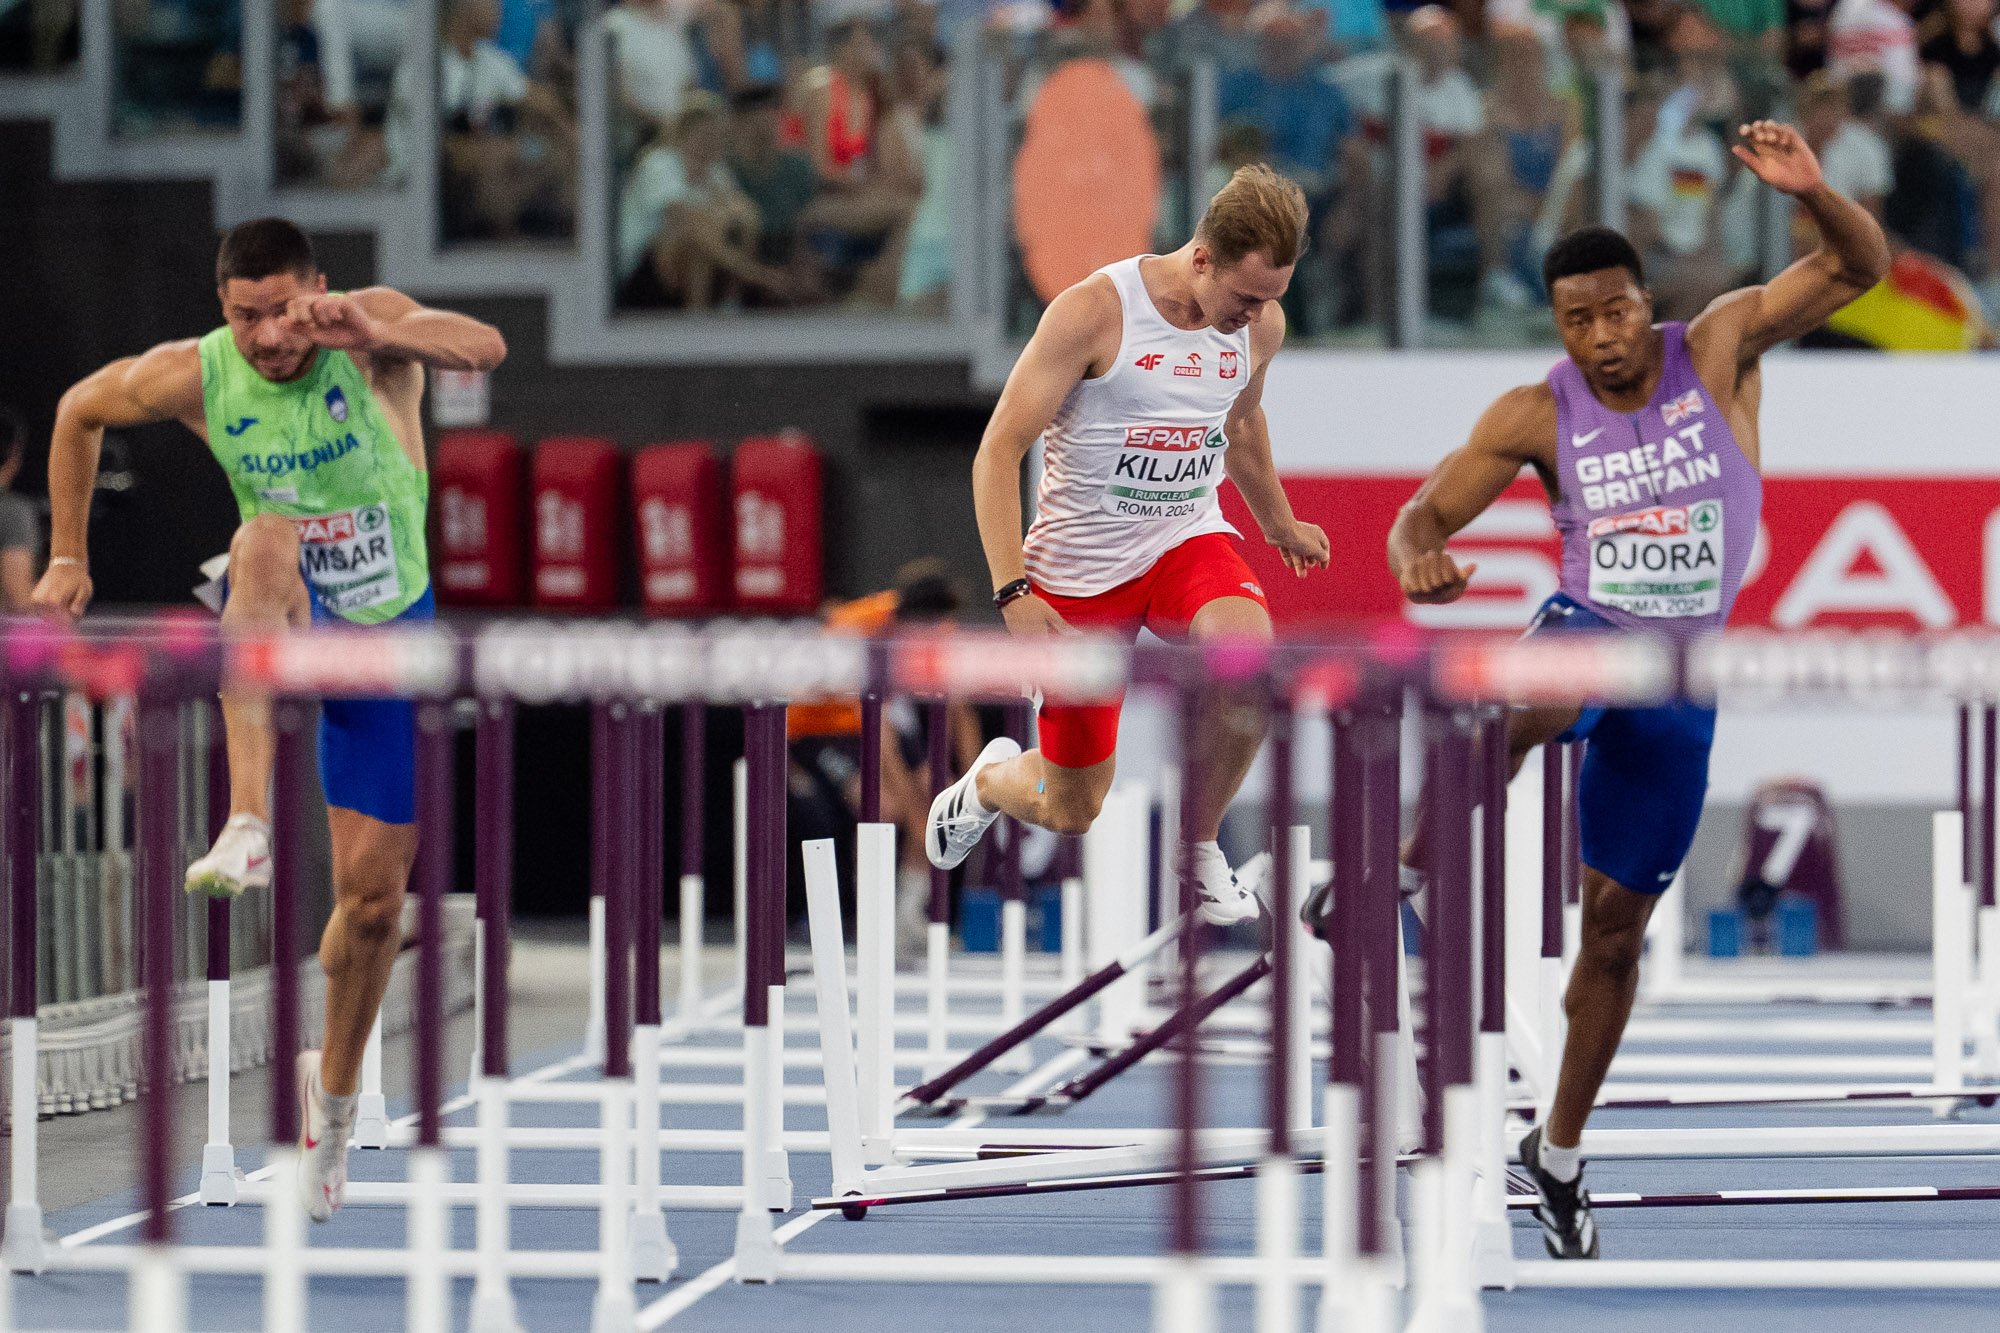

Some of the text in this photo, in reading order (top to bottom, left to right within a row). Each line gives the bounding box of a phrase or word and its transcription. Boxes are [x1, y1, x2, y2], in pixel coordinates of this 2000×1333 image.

[1135, 353, 1165, 370] 4F
[1175, 367, 1201, 376] ORLEN
[1127, 428, 1205, 448] SPAR
[1575, 421, 1705, 484] GREAT
[241, 432, 360, 474] SLOVENIJA
[1114, 453, 1216, 482] KILJAN
[1129, 489, 1191, 501] I RUN CLEAN
[1582, 452, 1721, 511] BRITAIN
[1116, 500, 1195, 517] ROMA 2024
[1596, 540, 1716, 571] OJORA
[1757, 804, 1816, 887] 7
